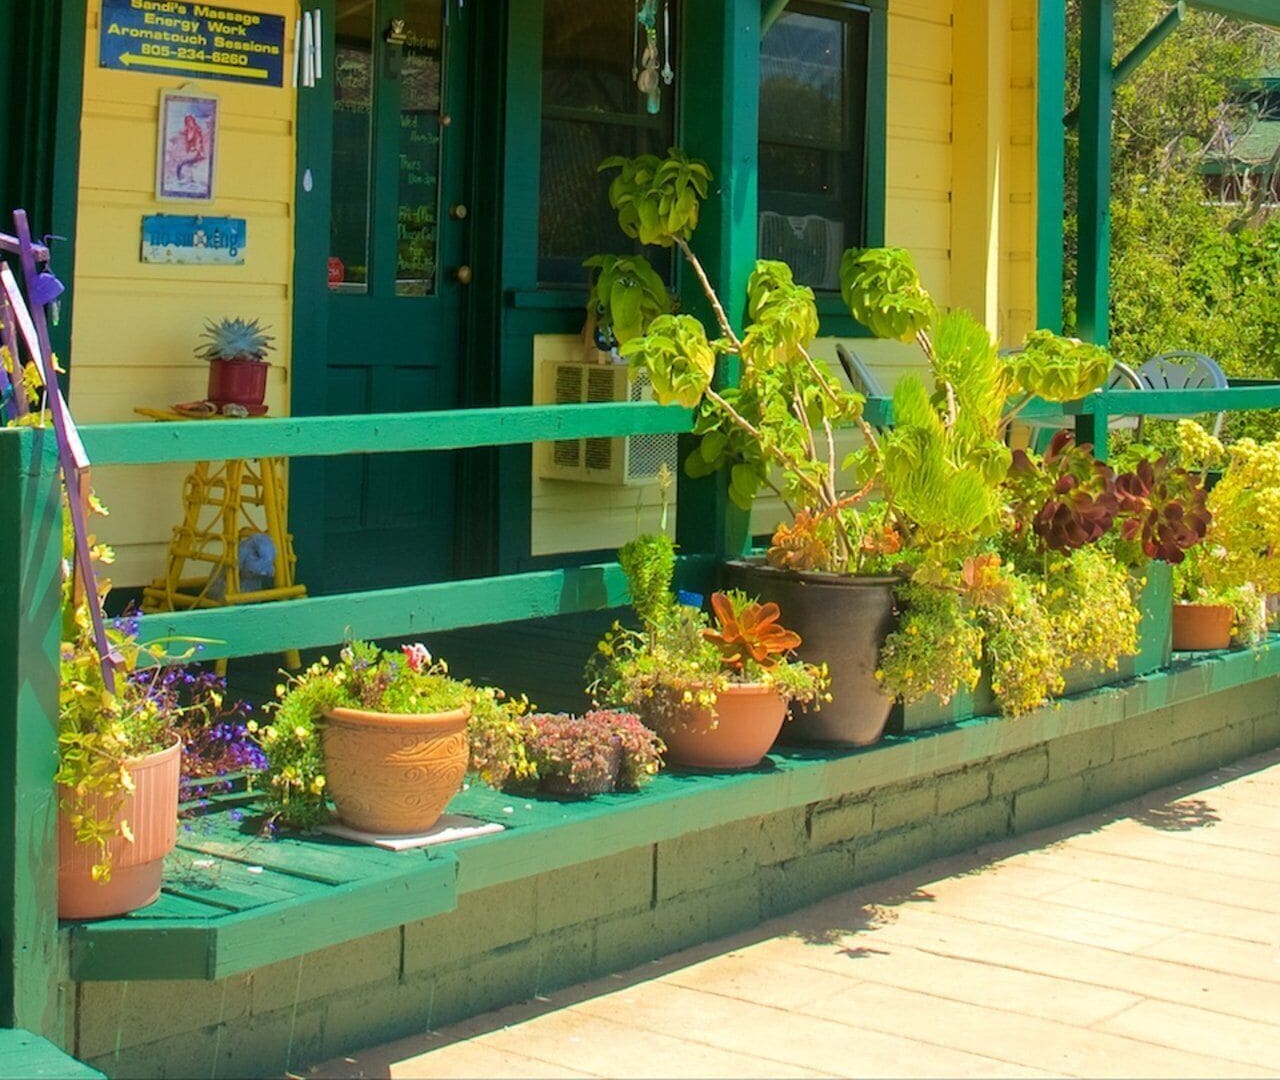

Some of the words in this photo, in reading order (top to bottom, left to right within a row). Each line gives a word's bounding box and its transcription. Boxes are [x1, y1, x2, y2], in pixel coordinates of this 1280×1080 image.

[144, 13, 200, 33] Energy
[207, 21, 247, 37] Work
[193, 5, 261, 26] Massage
[108, 23, 207, 46] Aromatouch
[213, 36, 280, 55] Sessions
